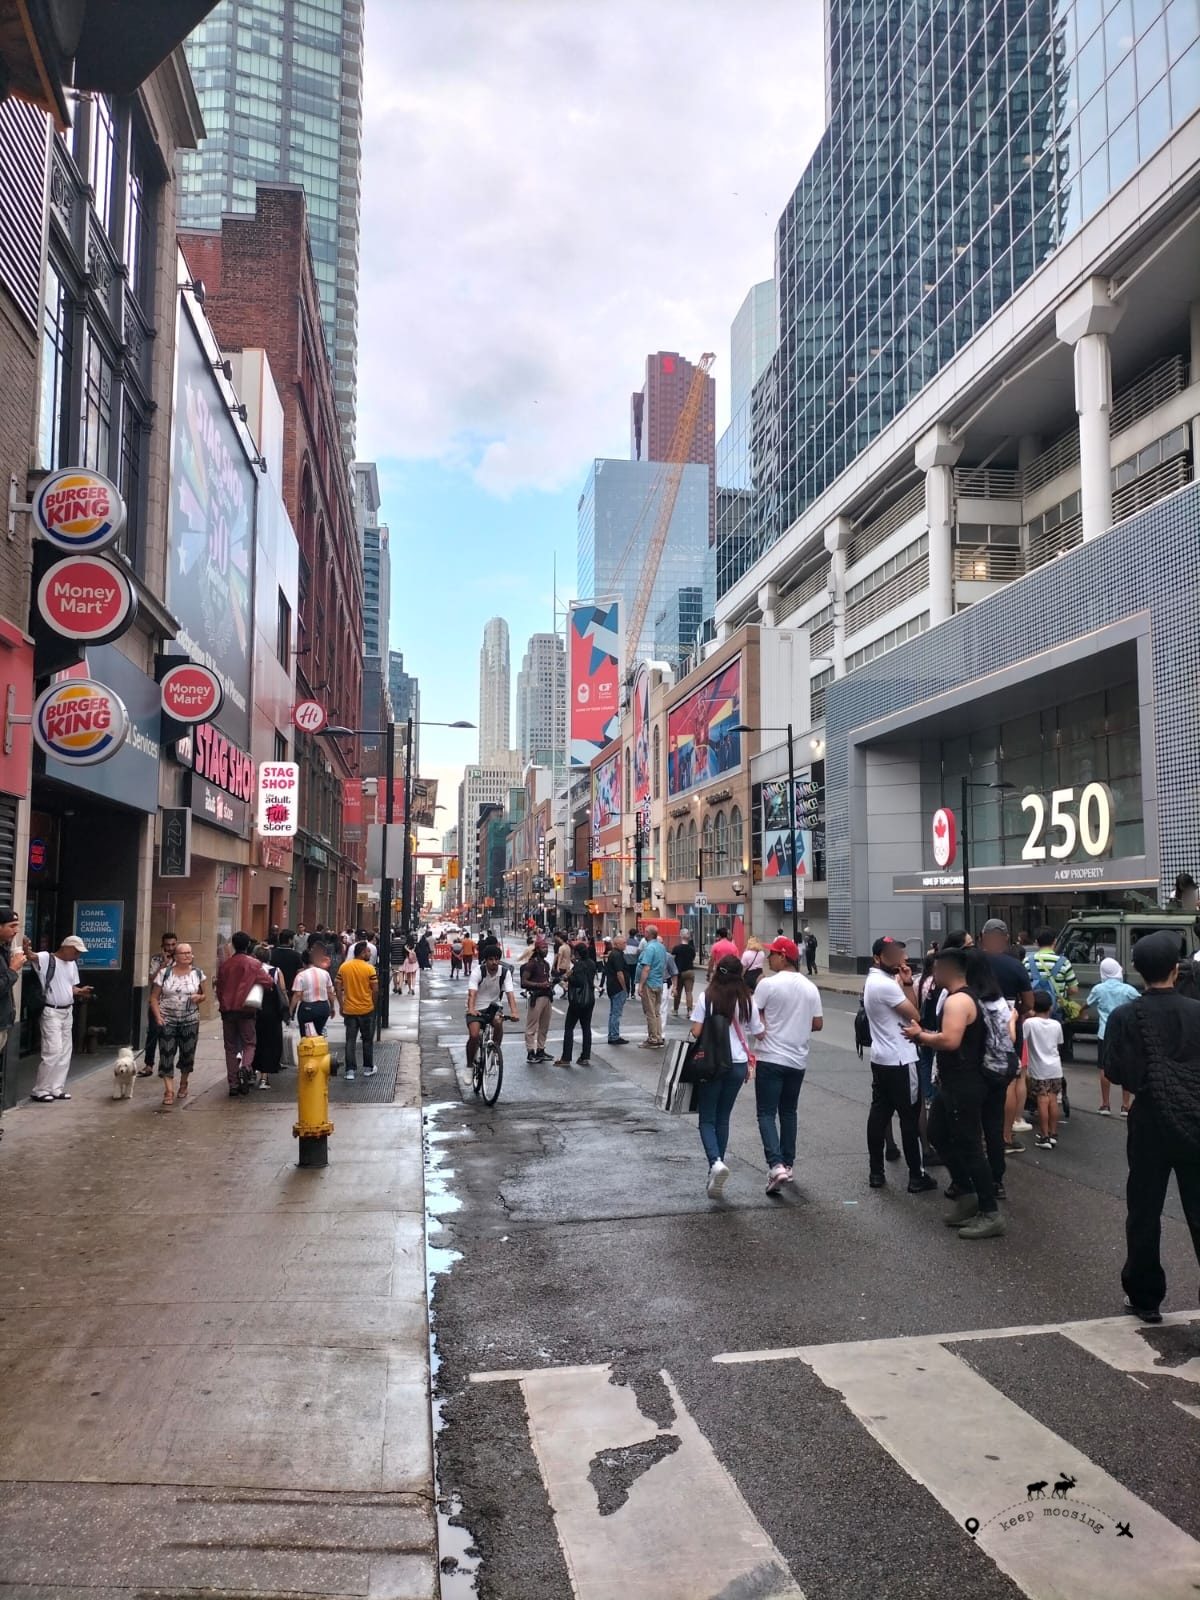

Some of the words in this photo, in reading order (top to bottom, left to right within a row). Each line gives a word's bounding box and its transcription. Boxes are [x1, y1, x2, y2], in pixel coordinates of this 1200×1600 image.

[45, 487, 108, 509] BURGER
[47, 499, 110, 529] KING
[54, 582, 116, 603] Money
[60, 598, 103, 614] Mart
[169, 683, 212, 697] Money
[173, 693, 204, 705] Mart
[45, 697, 110, 721] BURGER
[299, 705, 319, 725] Hi
[47, 711, 111, 742] KING
[132, 724, 158, 760] Services
[194, 723, 229, 790] STAG
[228, 744, 257, 804] SHOP
[263, 767, 295, 778] STAG
[261, 779, 296, 790] SHOP
[263, 822, 292, 832] store
[1021, 782, 1110, 860] 250
[1070, 867, 1105, 879] PROPERTY
[695, 898, 707, 906] 40
